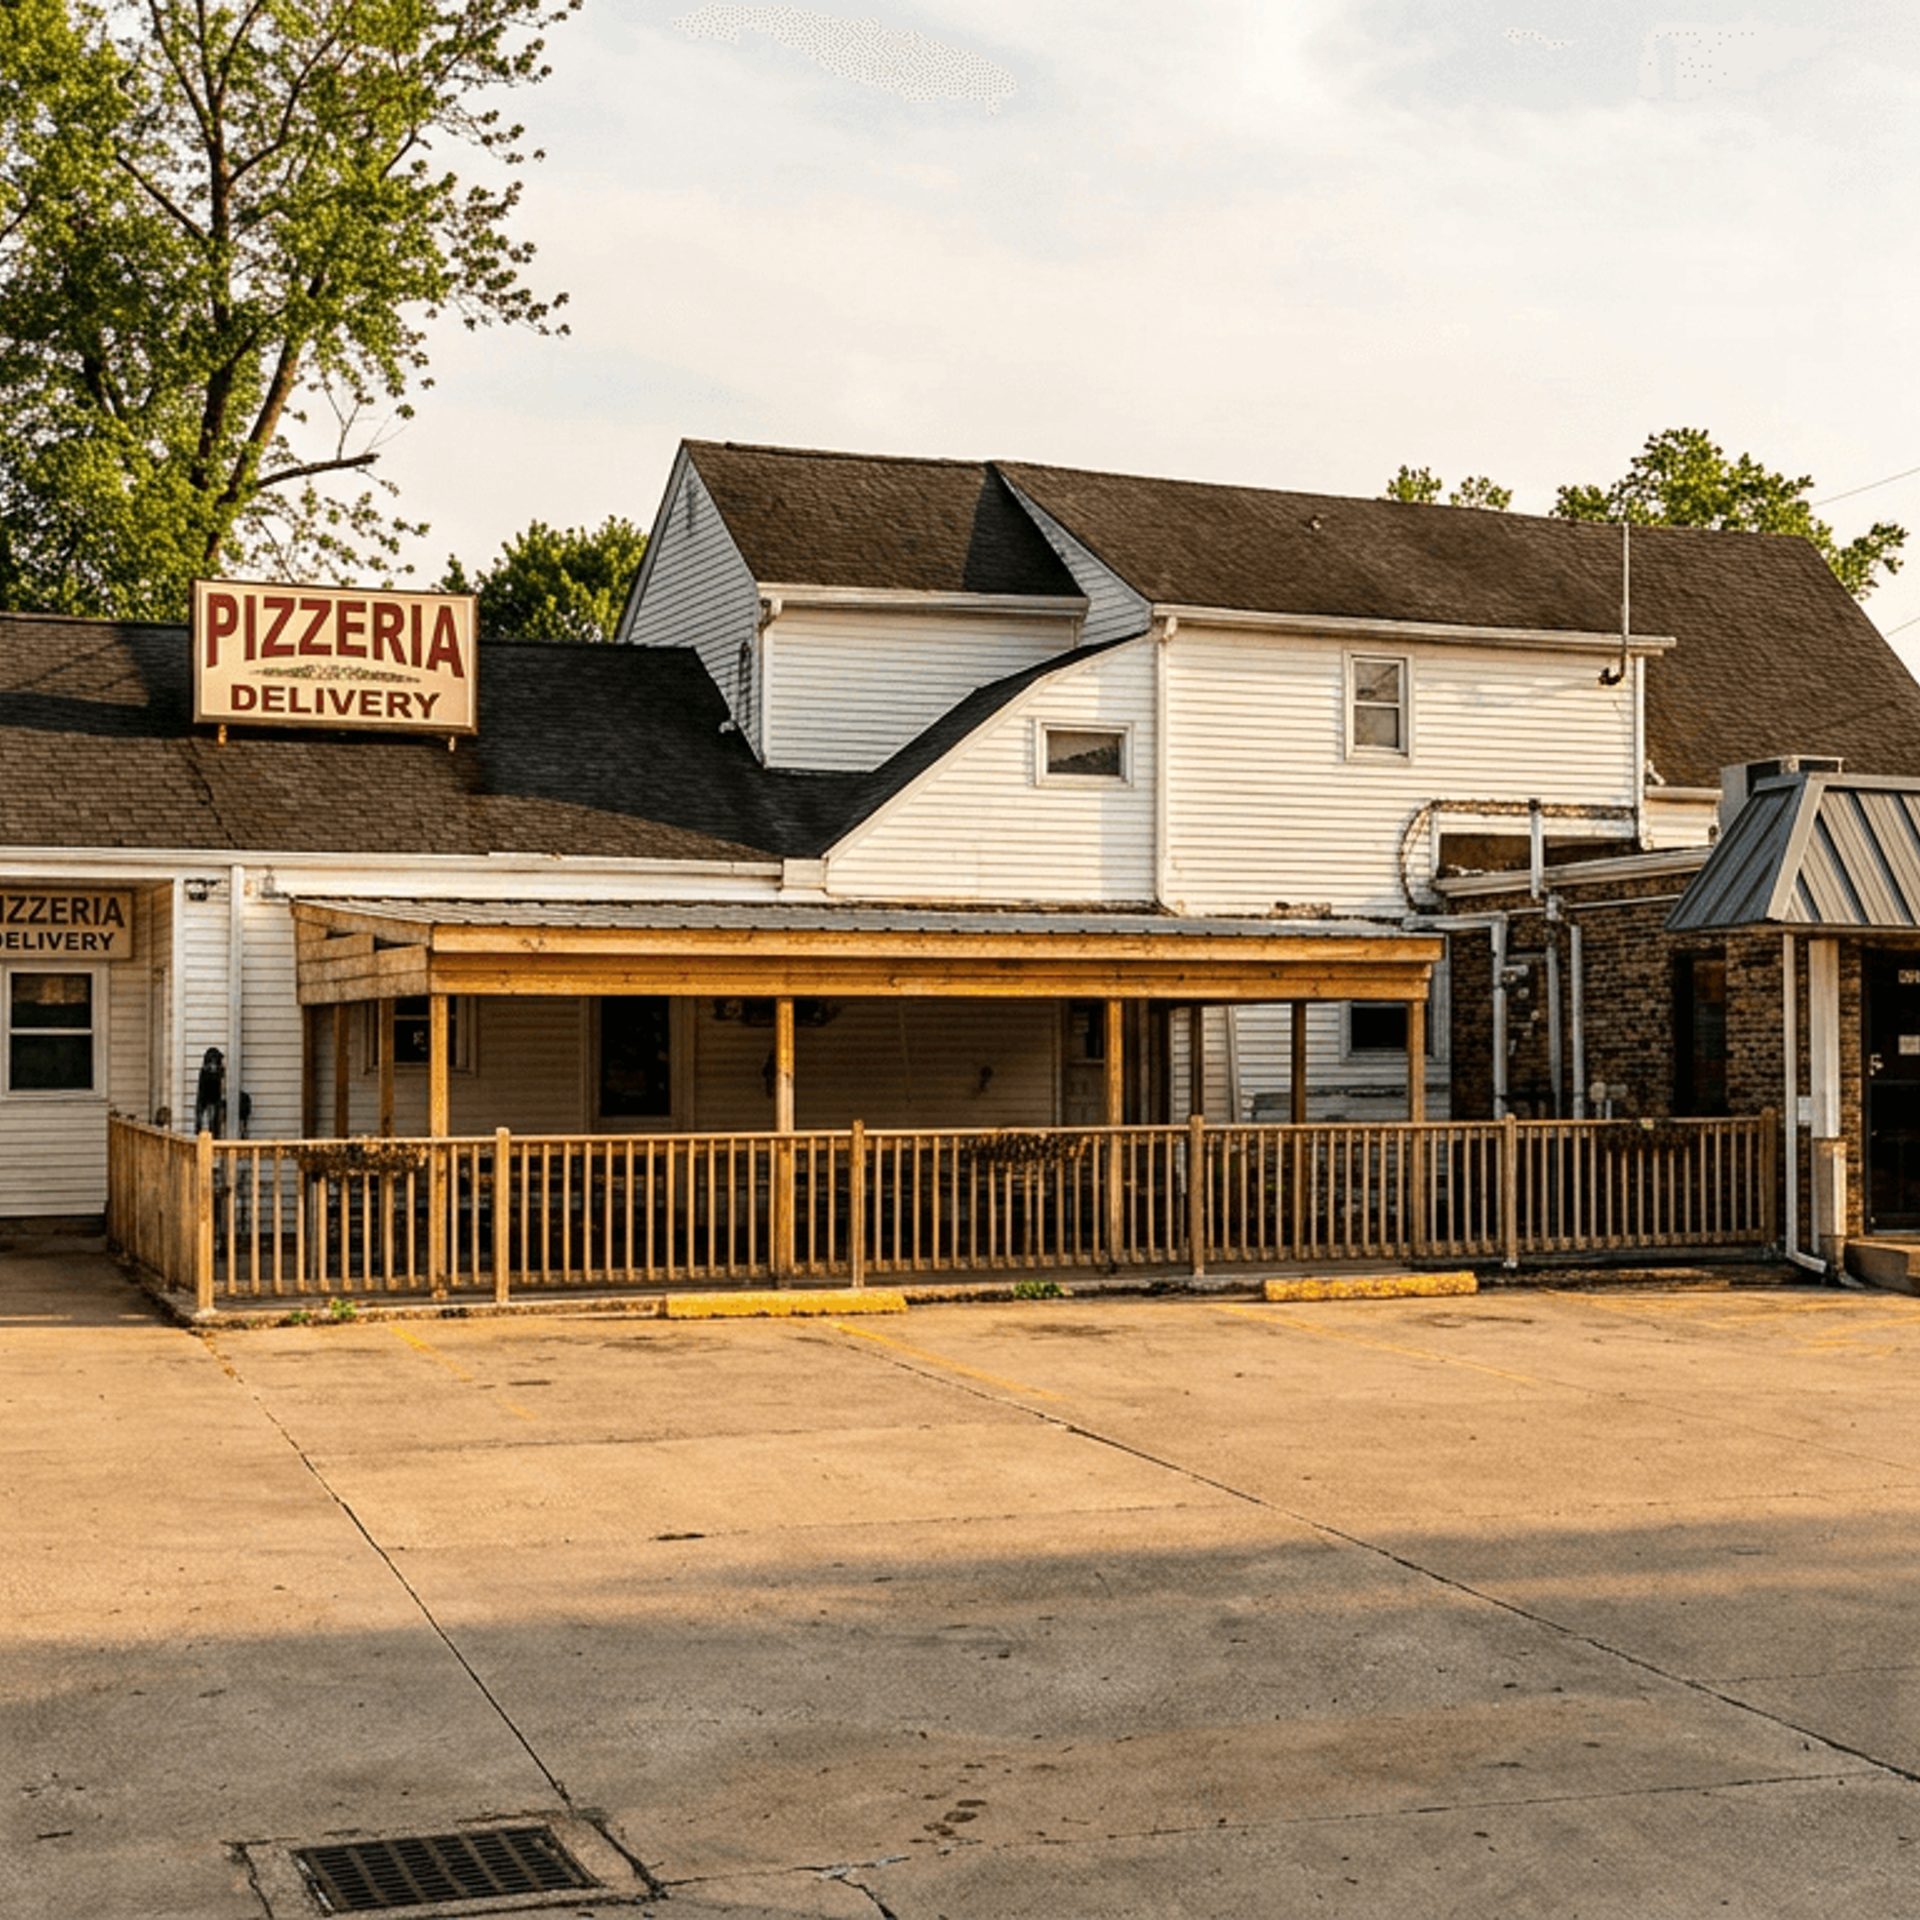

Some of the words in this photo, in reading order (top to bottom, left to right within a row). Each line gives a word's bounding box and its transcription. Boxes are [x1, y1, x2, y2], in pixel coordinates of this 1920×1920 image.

[206, 592, 465, 679] PIZZERIA
[231, 684, 441, 719] DELIVERY
[0, 895, 125, 928] IZZERIA
[0, 931, 115, 951] ELIVERY
